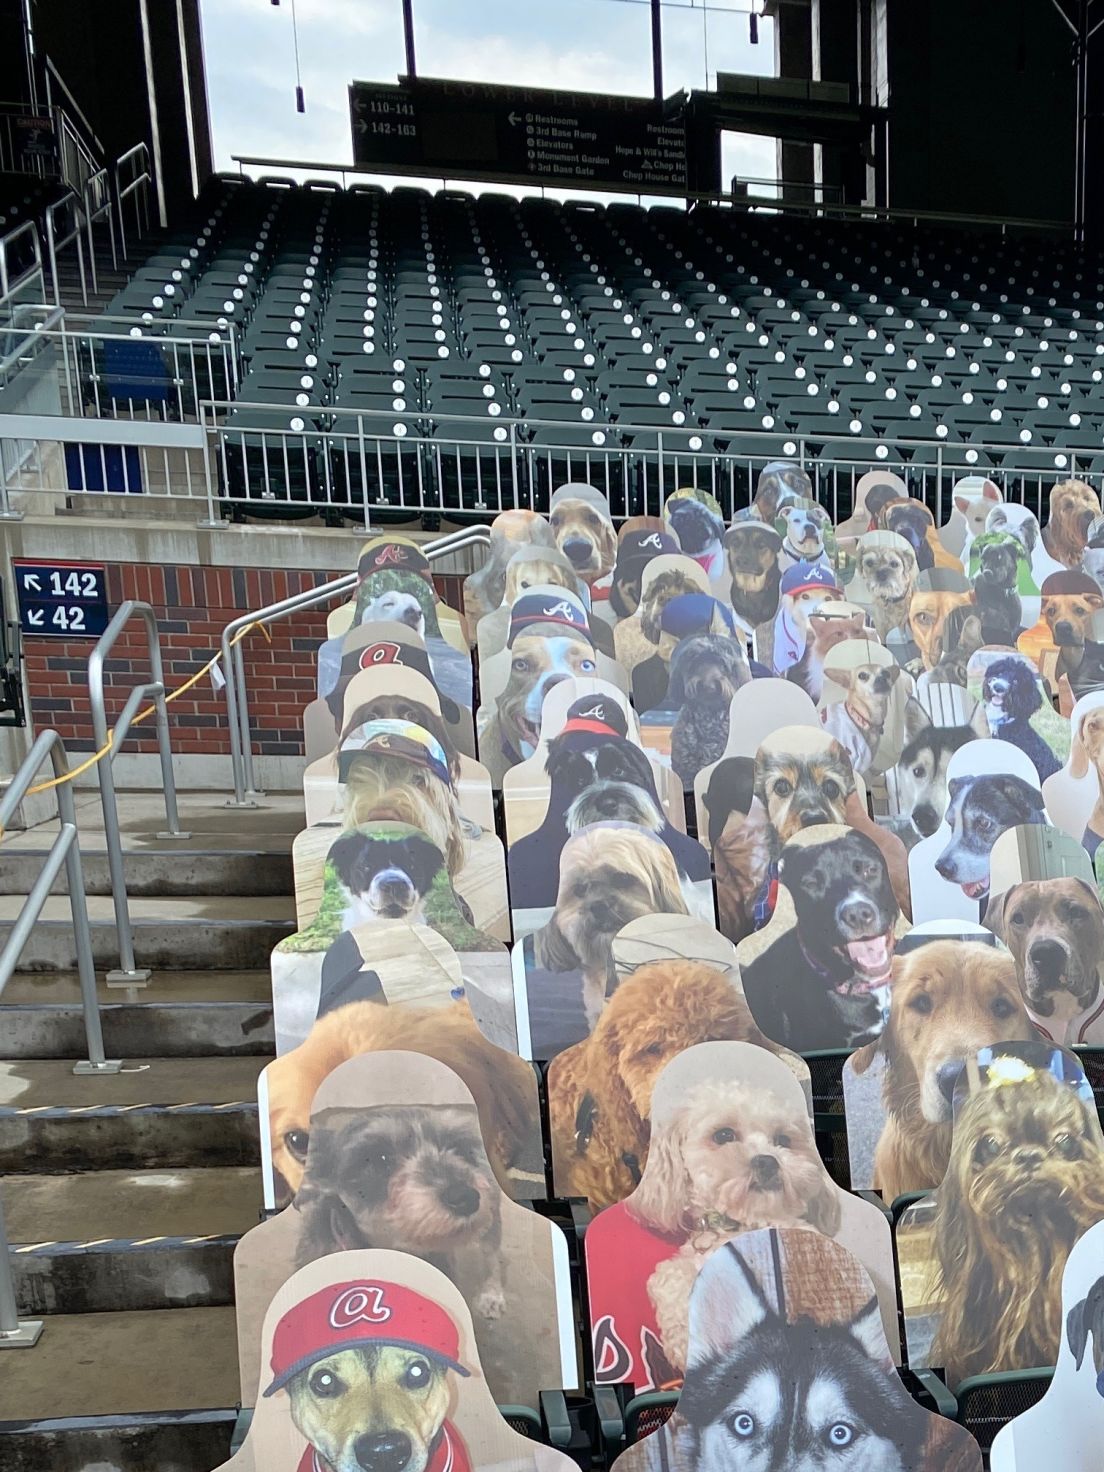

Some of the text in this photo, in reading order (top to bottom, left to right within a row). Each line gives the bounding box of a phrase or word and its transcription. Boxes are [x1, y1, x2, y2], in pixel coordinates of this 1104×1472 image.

[638, 533, 662, 549] A
[50, 572, 98, 597] 142
[52, 606, 86, 630] 42
[543, 602, 573, 622] A
[579, 704, 604, 720] A
